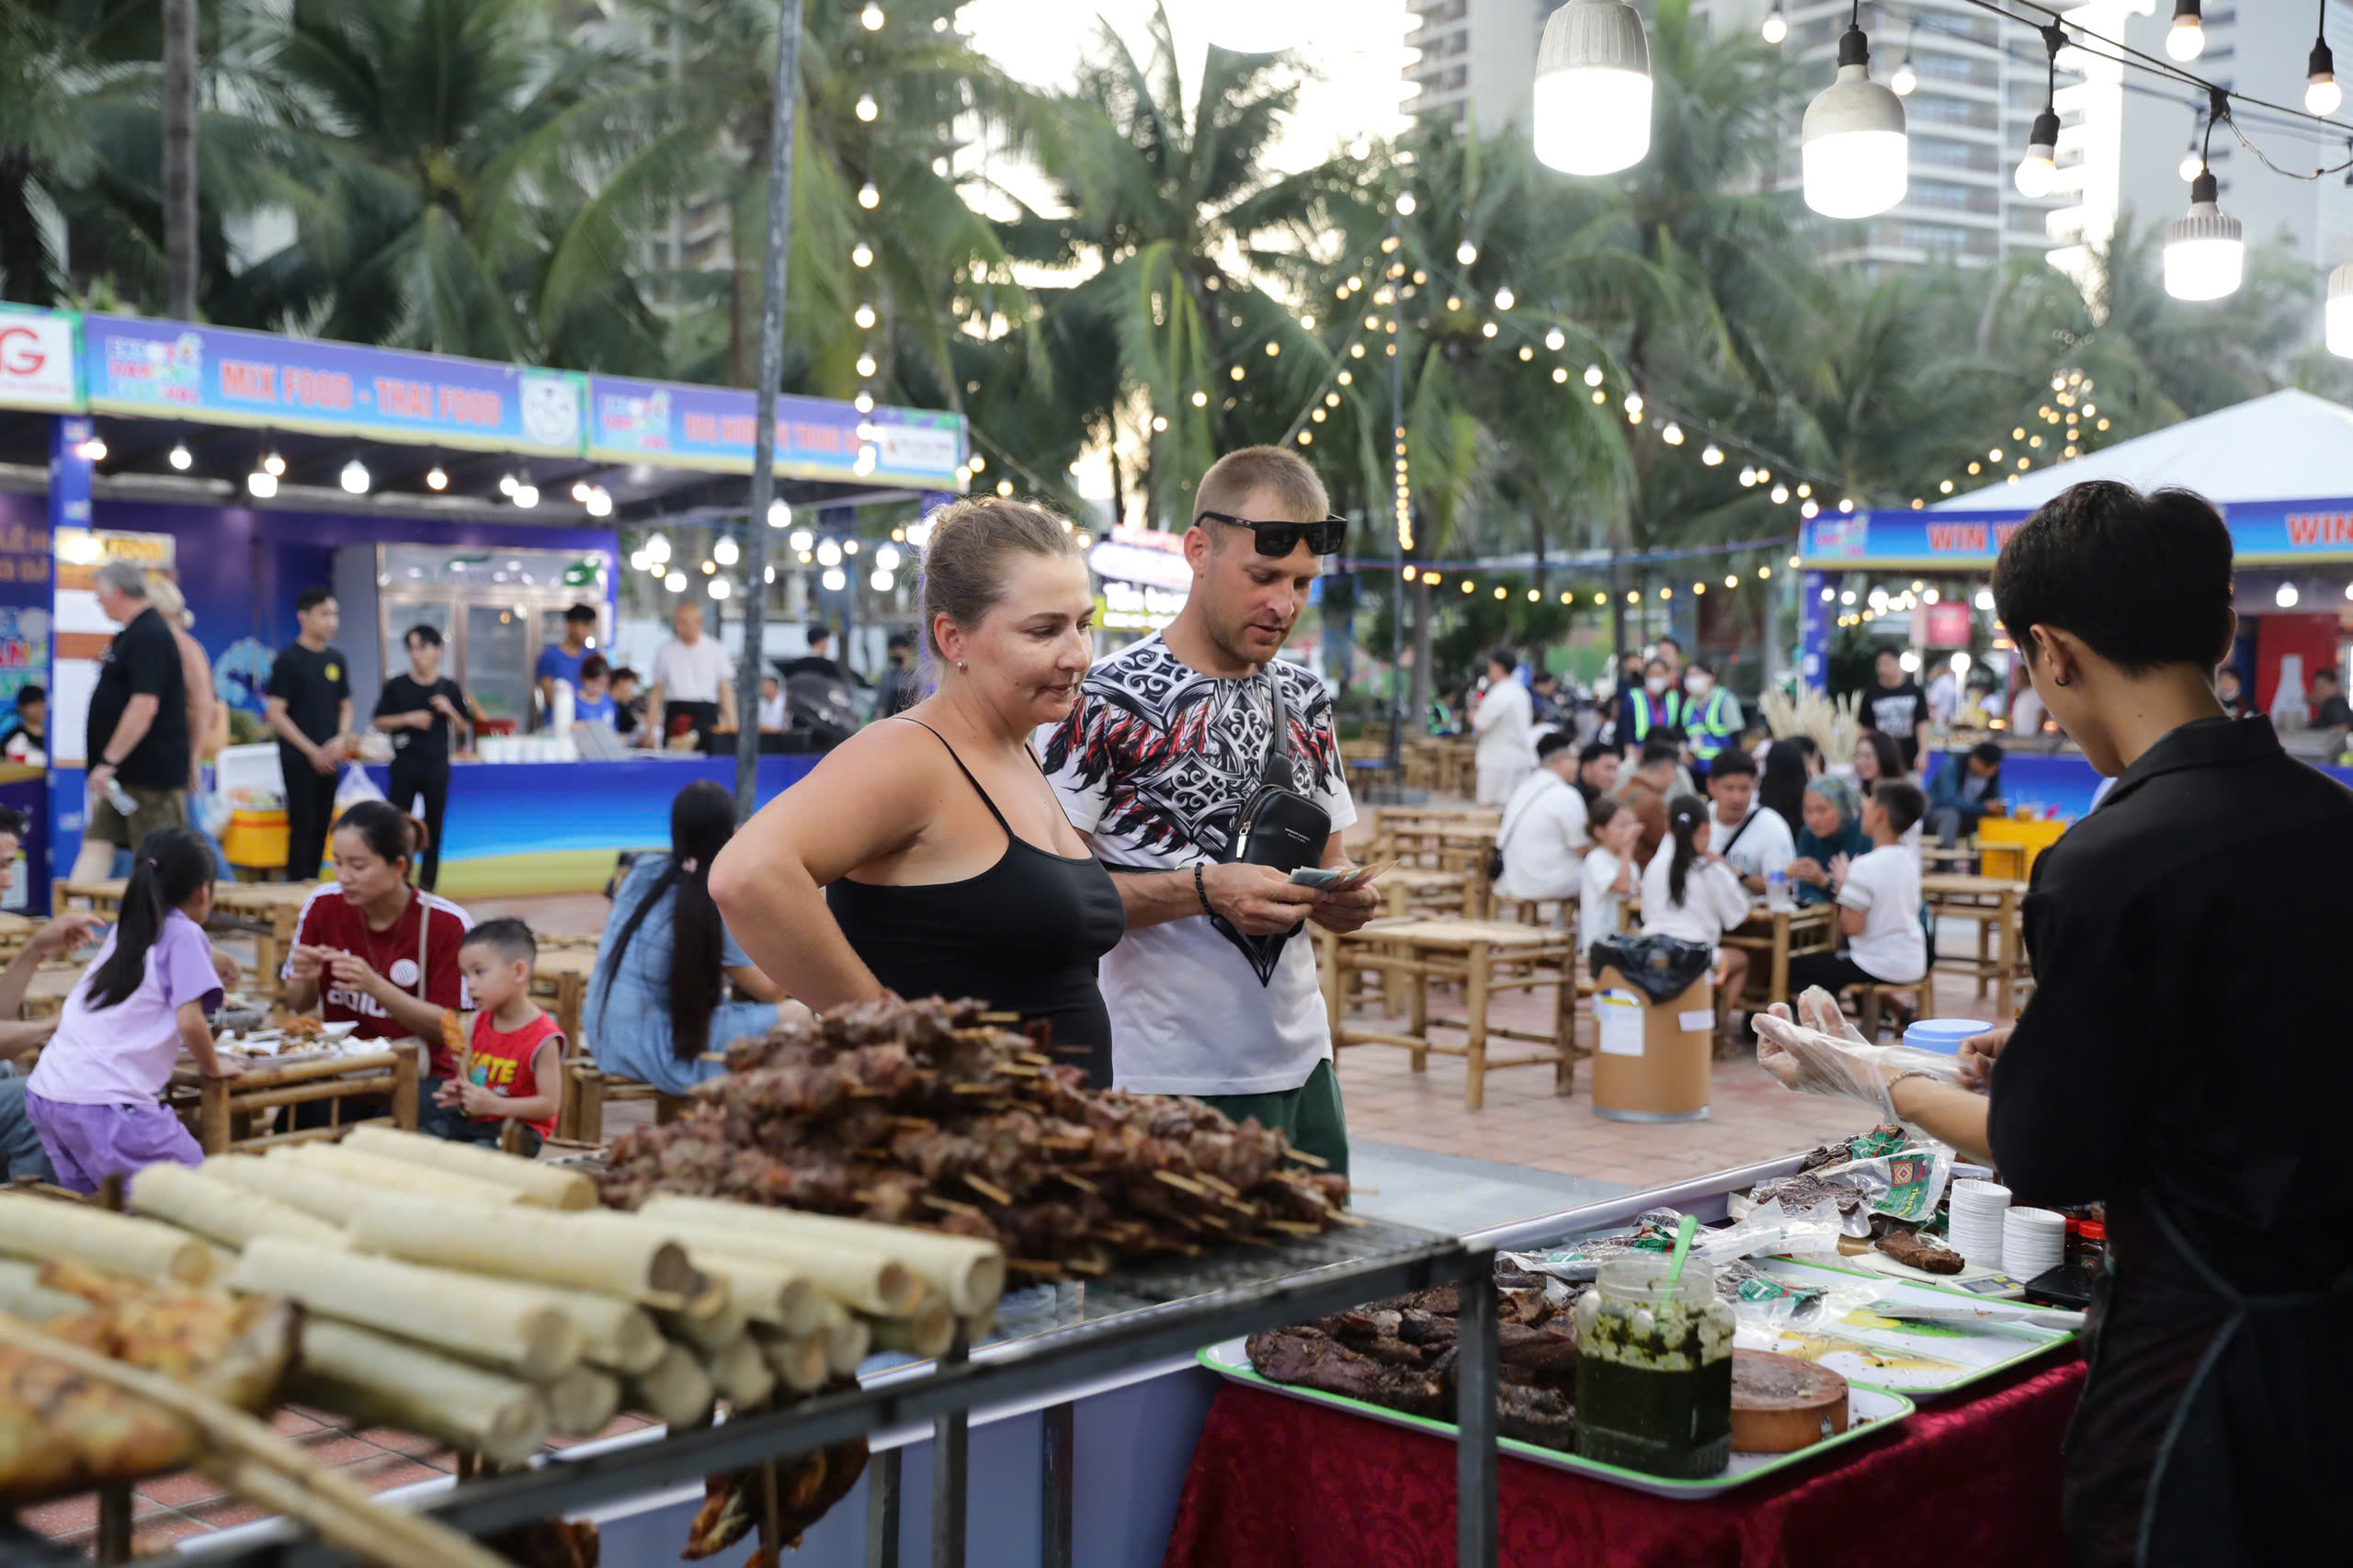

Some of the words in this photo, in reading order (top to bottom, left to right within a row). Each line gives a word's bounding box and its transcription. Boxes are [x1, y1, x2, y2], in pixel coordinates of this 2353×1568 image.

[220, 358, 276, 403] MIX
[281, 366, 353, 410] FOOD
[373, 377, 433, 420] THAI
[438, 384, 503, 428] FOOD
[1927, 521, 1989, 552] WIN
